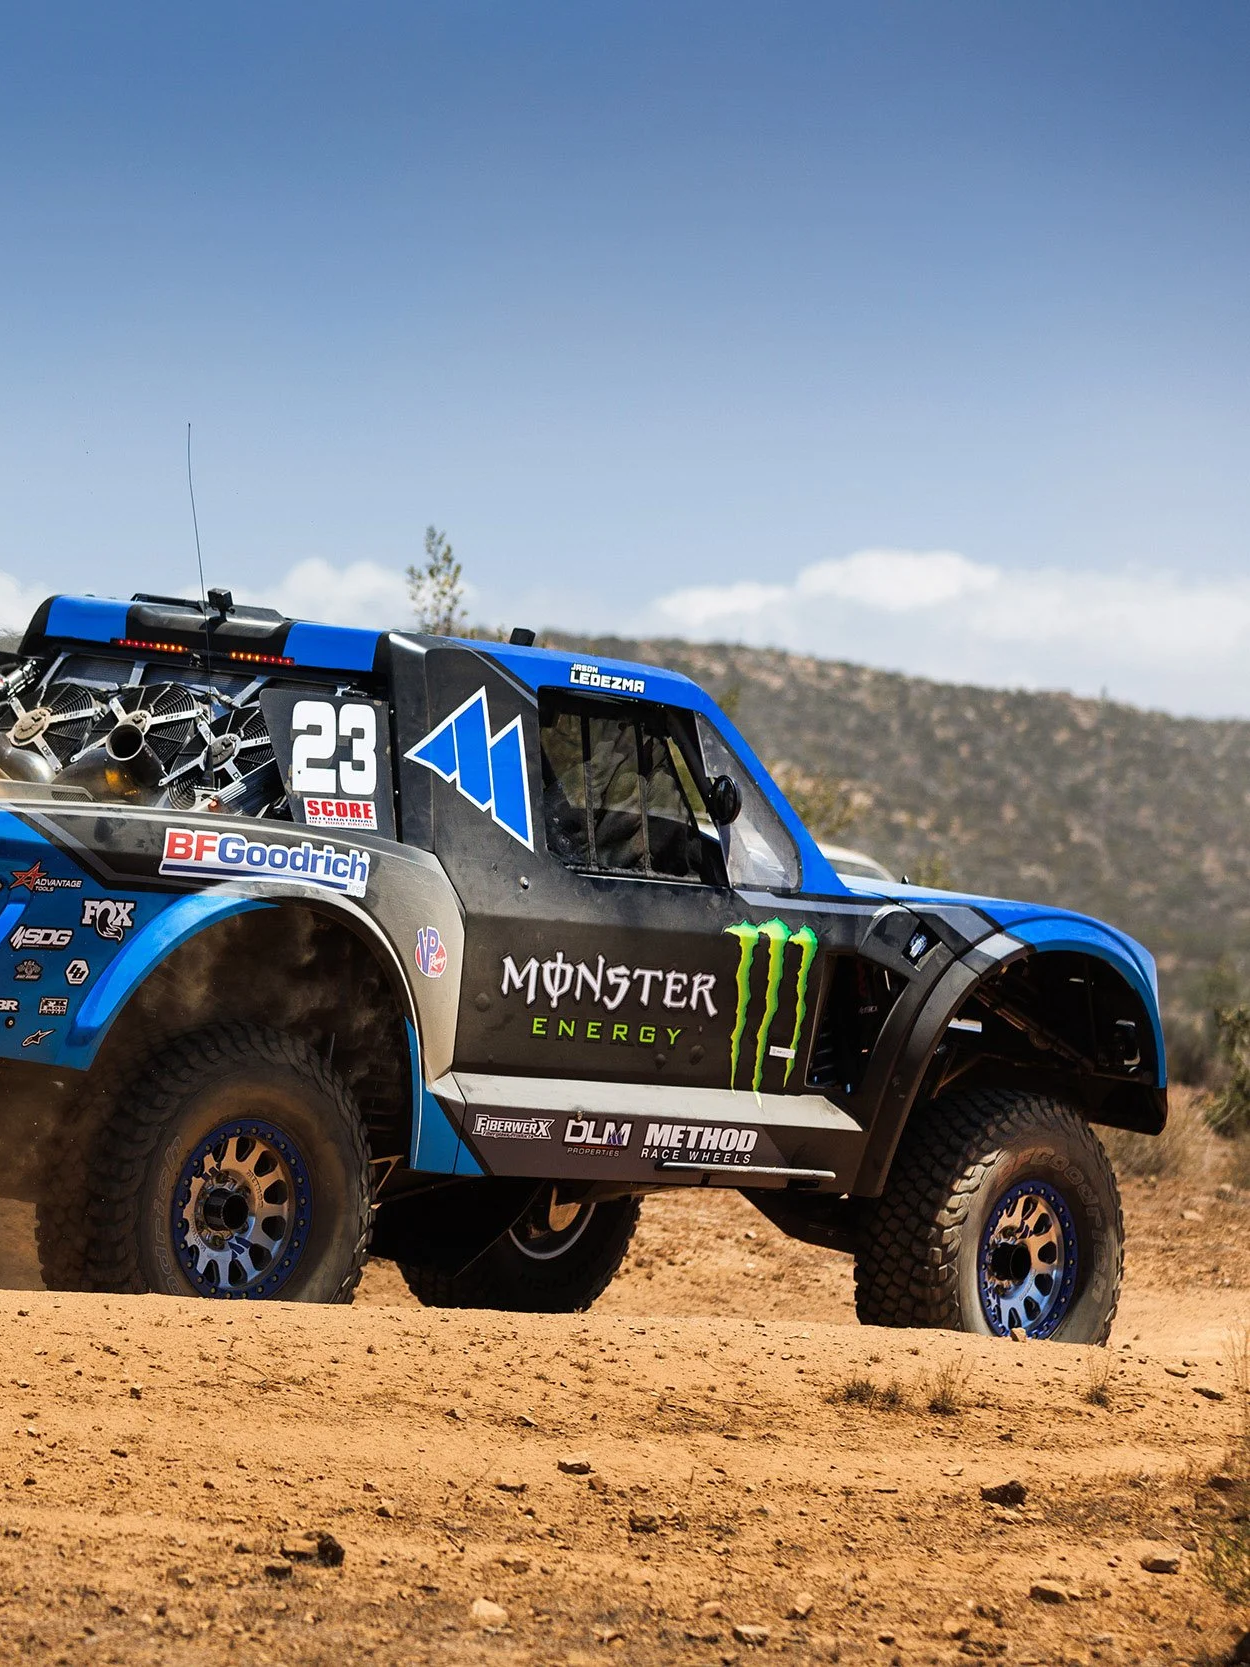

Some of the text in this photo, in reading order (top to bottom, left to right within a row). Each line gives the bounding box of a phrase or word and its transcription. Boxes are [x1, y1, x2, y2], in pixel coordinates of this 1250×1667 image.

[570, 671, 645, 693] LEDEZMA
[571, 663, 598, 673] JASON
[292, 700, 377, 796] 23
[307, 800, 373, 819] SCORE
[165, 831, 367, 882] BFGoodrich
[34, 878, 83, 888] ADVANTAGE
[82, 900, 135, 940] FOX
[418, 928, 439, 975] VP
[501, 951, 719, 1018] MONSTER
[532, 1017, 682, 1045] ENERGY
[564, 1119, 633, 1147] DLM
[644, 1123, 758, 1152] METHOD
[567, 1147, 620, 1157] PROPERTIES
[641, 1148, 751, 1164] RACE WHEELS
